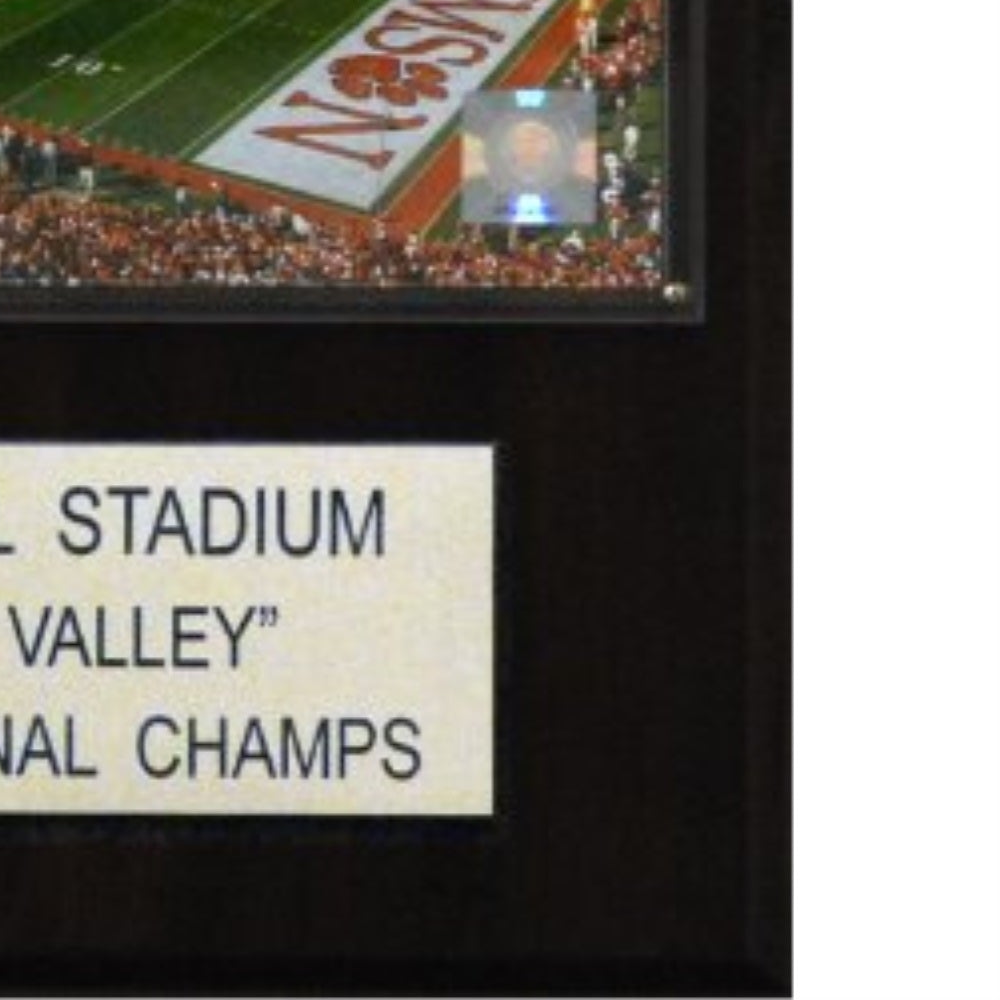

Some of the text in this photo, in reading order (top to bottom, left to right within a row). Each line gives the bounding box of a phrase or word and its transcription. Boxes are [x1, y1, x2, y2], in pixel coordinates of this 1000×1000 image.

[57, 486, 386, 558] STADIUM
[7, 604, 279, 669] VALLEY”
[135, 714, 423, 781] CHAMPS
